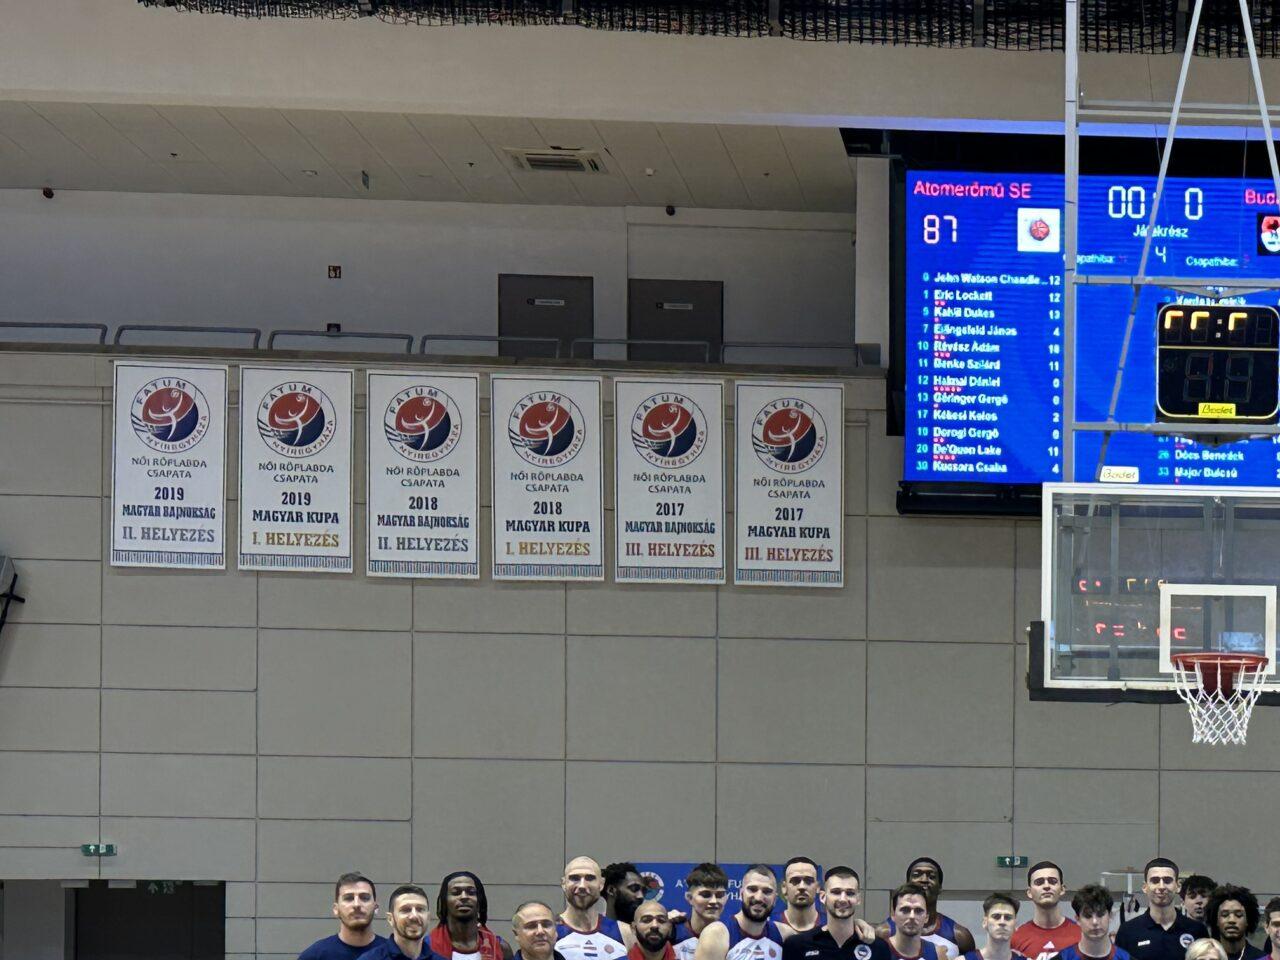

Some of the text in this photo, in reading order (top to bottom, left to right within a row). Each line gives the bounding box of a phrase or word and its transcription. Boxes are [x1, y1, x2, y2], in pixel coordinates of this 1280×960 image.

[1010, 183, 1031, 198] SE
[1108, 186, 1145, 218] 00
[1185, 188, 1202, 220] 0
[923, 215, 958, 244] 87
[1155, 246, 1166, 263] 4
[1049, 276, 1060, 285] 12
[934, 290, 954, 300] Eric
[137, 379, 186, 405] FATUM
[263, 384, 312, 410] FATUM
[390, 388, 438, 414] FATUM
[513, 393, 562, 419] FATUM
[637, 395, 684, 421] FATUM
[757, 401, 804, 426] FATUM
[147, 470, 192, 478] CSAPATA
[274, 474, 318, 483] CSAPATA
[401, 479, 445, 488] CSAPATA
[526, 484, 569, 493] CSAPATA
[648, 485, 691, 494] CSAPATA
[154, 486, 184, 500] 2019
[281, 492, 311, 505] 2019
[768, 490, 810, 499] CSAPATA
[122, 504, 160, 516] MAGYAR
[409, 497, 437, 510] 2018
[533, 501, 562, 515] 2018
[656, 503, 684, 516] 2017
[253, 510, 339, 524] MAGYAR KUPA
[377, 515, 415, 526] MAGYAR
[775, 508, 803, 521] 2017
[122, 524, 214, 542] II. HELYEZÉS
[506, 520, 590, 532] MAGYAR KUPA
[625, 521, 663, 533] MAGYAR
[748, 526, 830, 539] MAGYAR KUPA
[253, 530, 339, 547] I. HELYEZÉS
[378, 534, 468, 552] II. HELYEZÉS
[506, 539, 590, 556] I. HELYEZÉS
[626, 540, 715, 557] III. HELYEZÉS
[745, 544, 833, 562] III. HELYEZÉS
